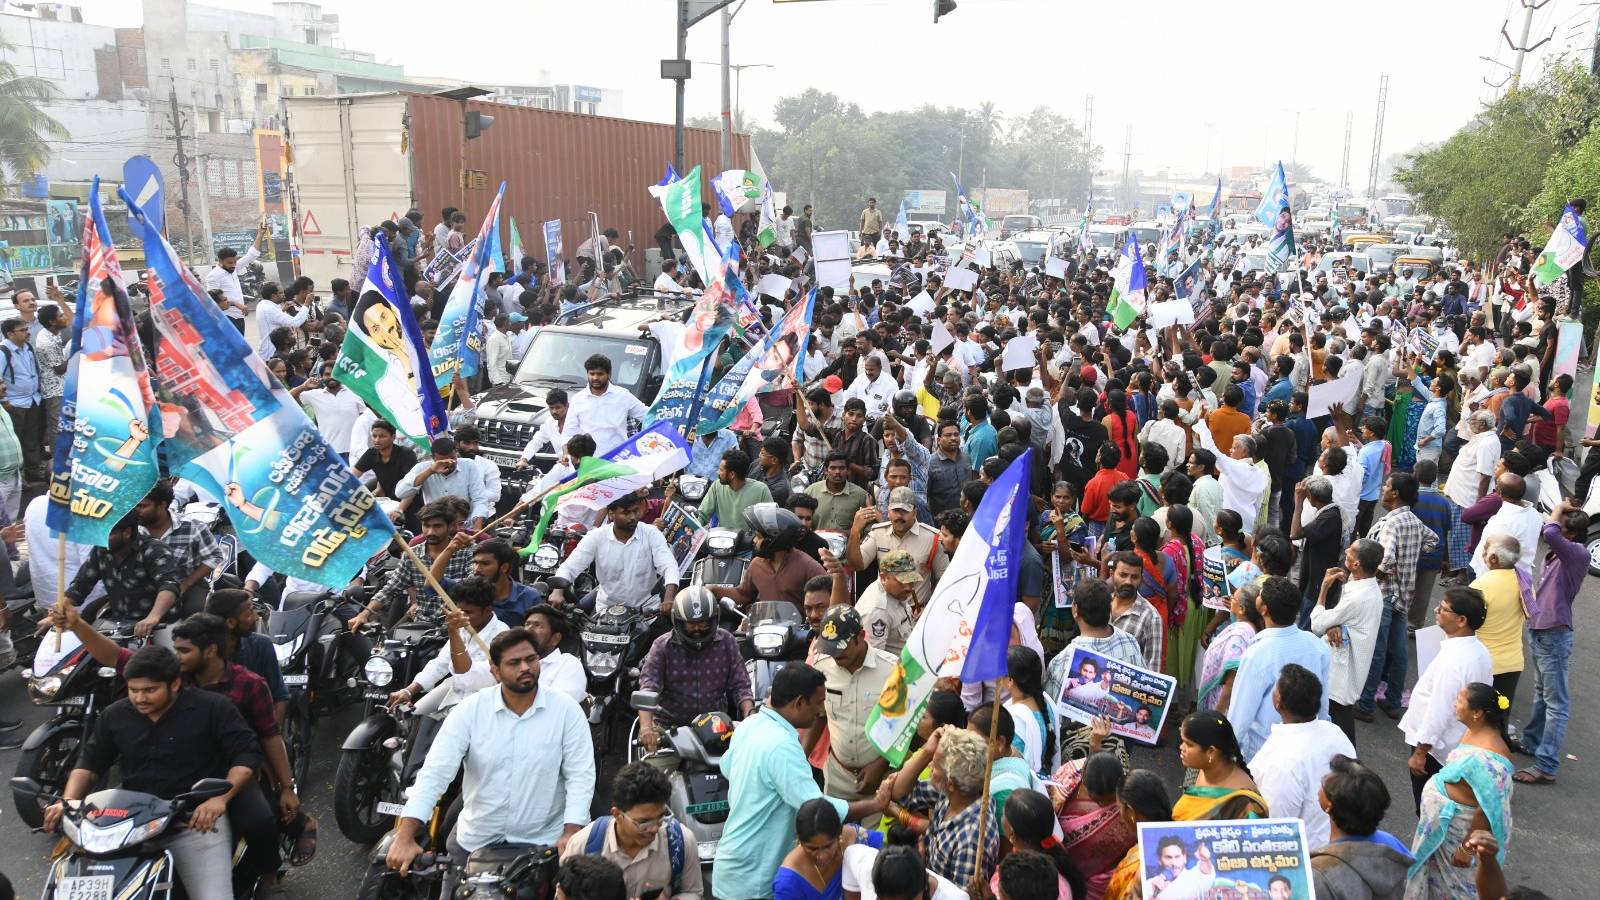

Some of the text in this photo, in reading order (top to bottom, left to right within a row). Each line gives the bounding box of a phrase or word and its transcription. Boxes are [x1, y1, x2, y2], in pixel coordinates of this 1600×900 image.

[1106, 660, 1122, 673] ప్రభుత్వ
[1113, 673, 1167, 697] కోటి సంతకాల
[1111, 683, 1163, 706] ప్రజా ఉద్యమం
[1195, 827, 1220, 839] ప్రభుత్వ
[1221, 827, 1241, 839] వైద్యం
[1271, 825, 1294, 836] హక్కు
[1213, 839, 1298, 853] కోటి సంతకాల
[1217, 855, 1298, 872] ప్రజా ఉద్యమం
[71, 879, 108, 890] AP39H
